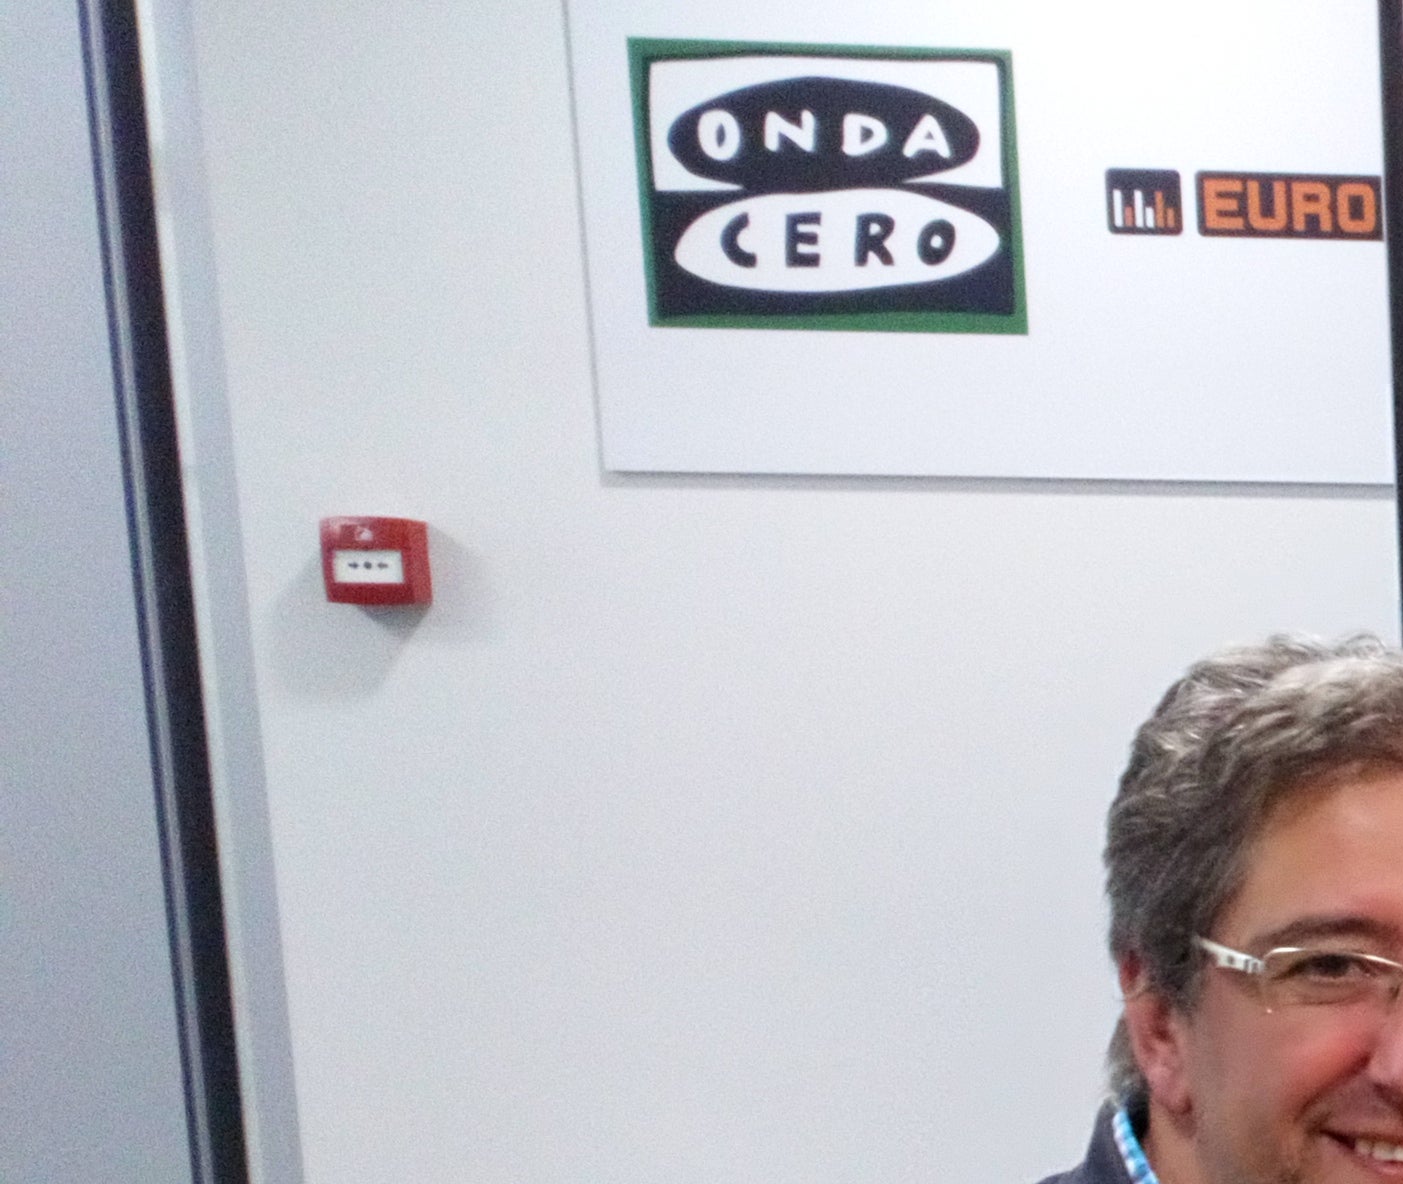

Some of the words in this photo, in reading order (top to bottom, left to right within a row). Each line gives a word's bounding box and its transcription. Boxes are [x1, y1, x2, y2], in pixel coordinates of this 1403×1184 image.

[697, 109, 952, 161] ONDA
[1203, 178, 1376, 233] EURO
[720, 211, 956, 268] CERO
